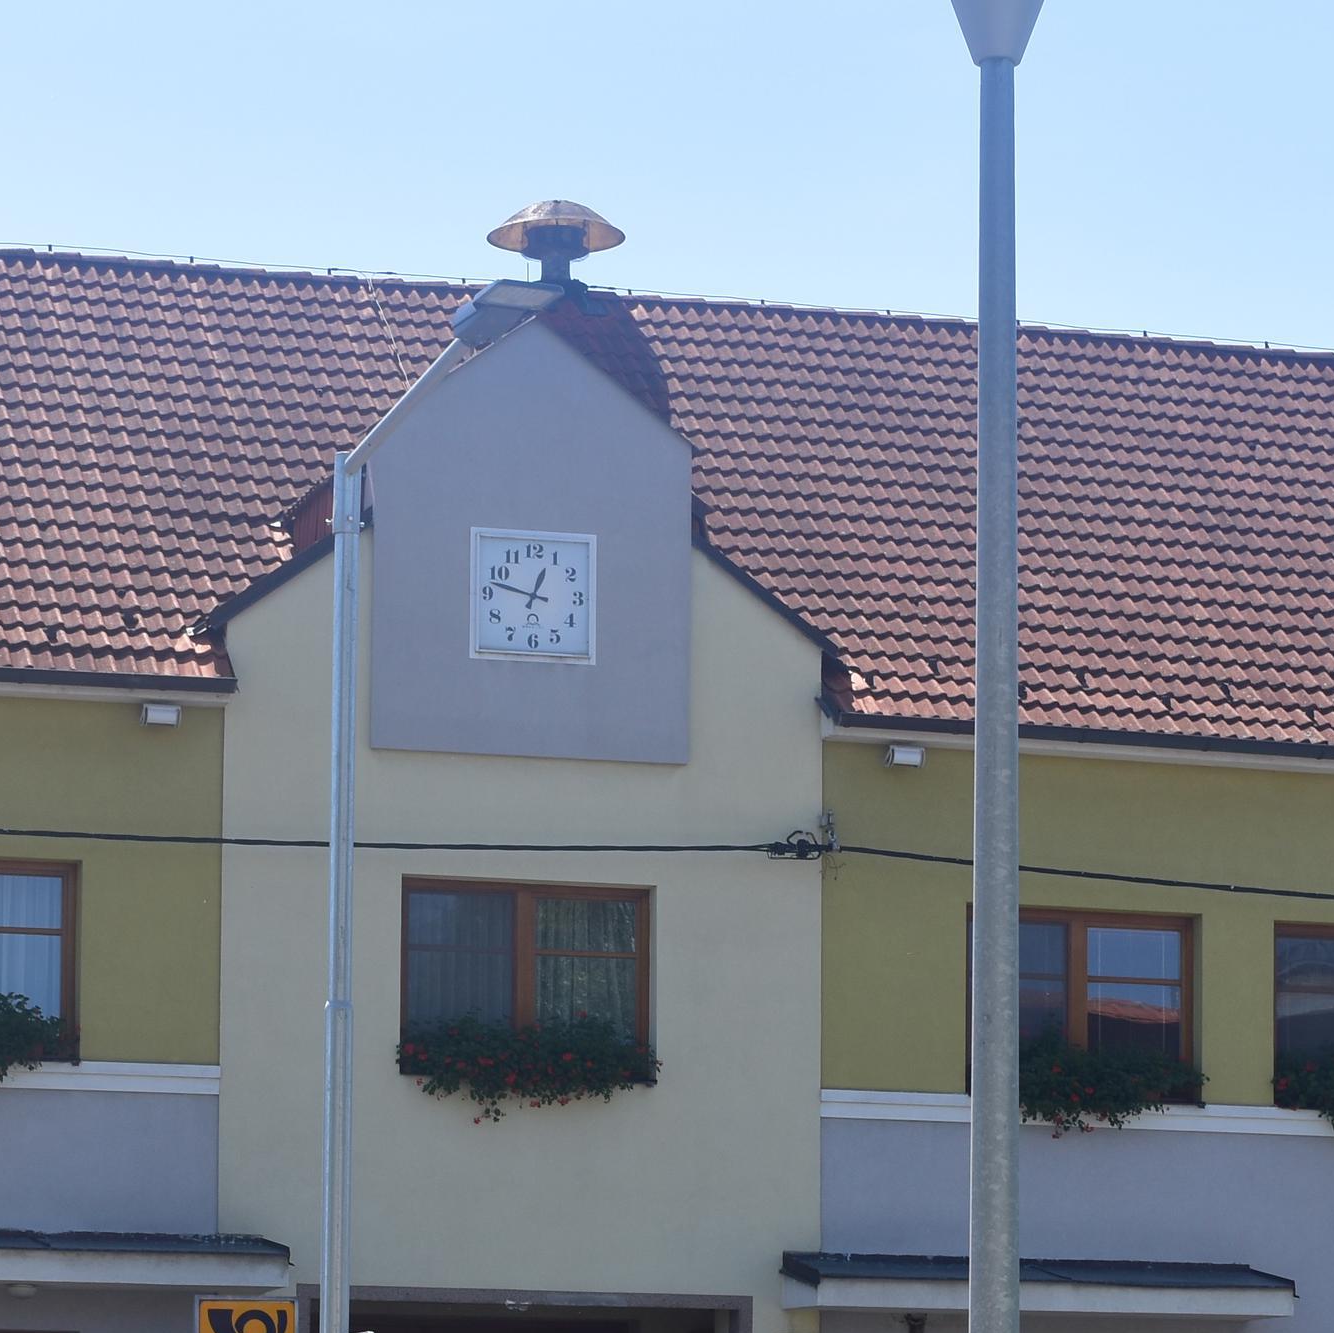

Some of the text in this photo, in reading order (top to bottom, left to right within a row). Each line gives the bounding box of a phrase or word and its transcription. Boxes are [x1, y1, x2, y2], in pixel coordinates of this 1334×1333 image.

[505, 549, 520, 564] 11
[525, 543, 544, 559] 12
[551, 551, 559, 566] 1
[490, 565, 510, 581] 10
[565, 567, 577, 582] 2
[482, 586, 494, 601] 9
[572, 591, 584, 606] 3
[489, 609, 502, 624] 8
[564, 613, 577, 628] 4
[505, 626, 516, 642] 7
[527, 633, 539, 649] 6
[549, 629, 561, 644] 5
